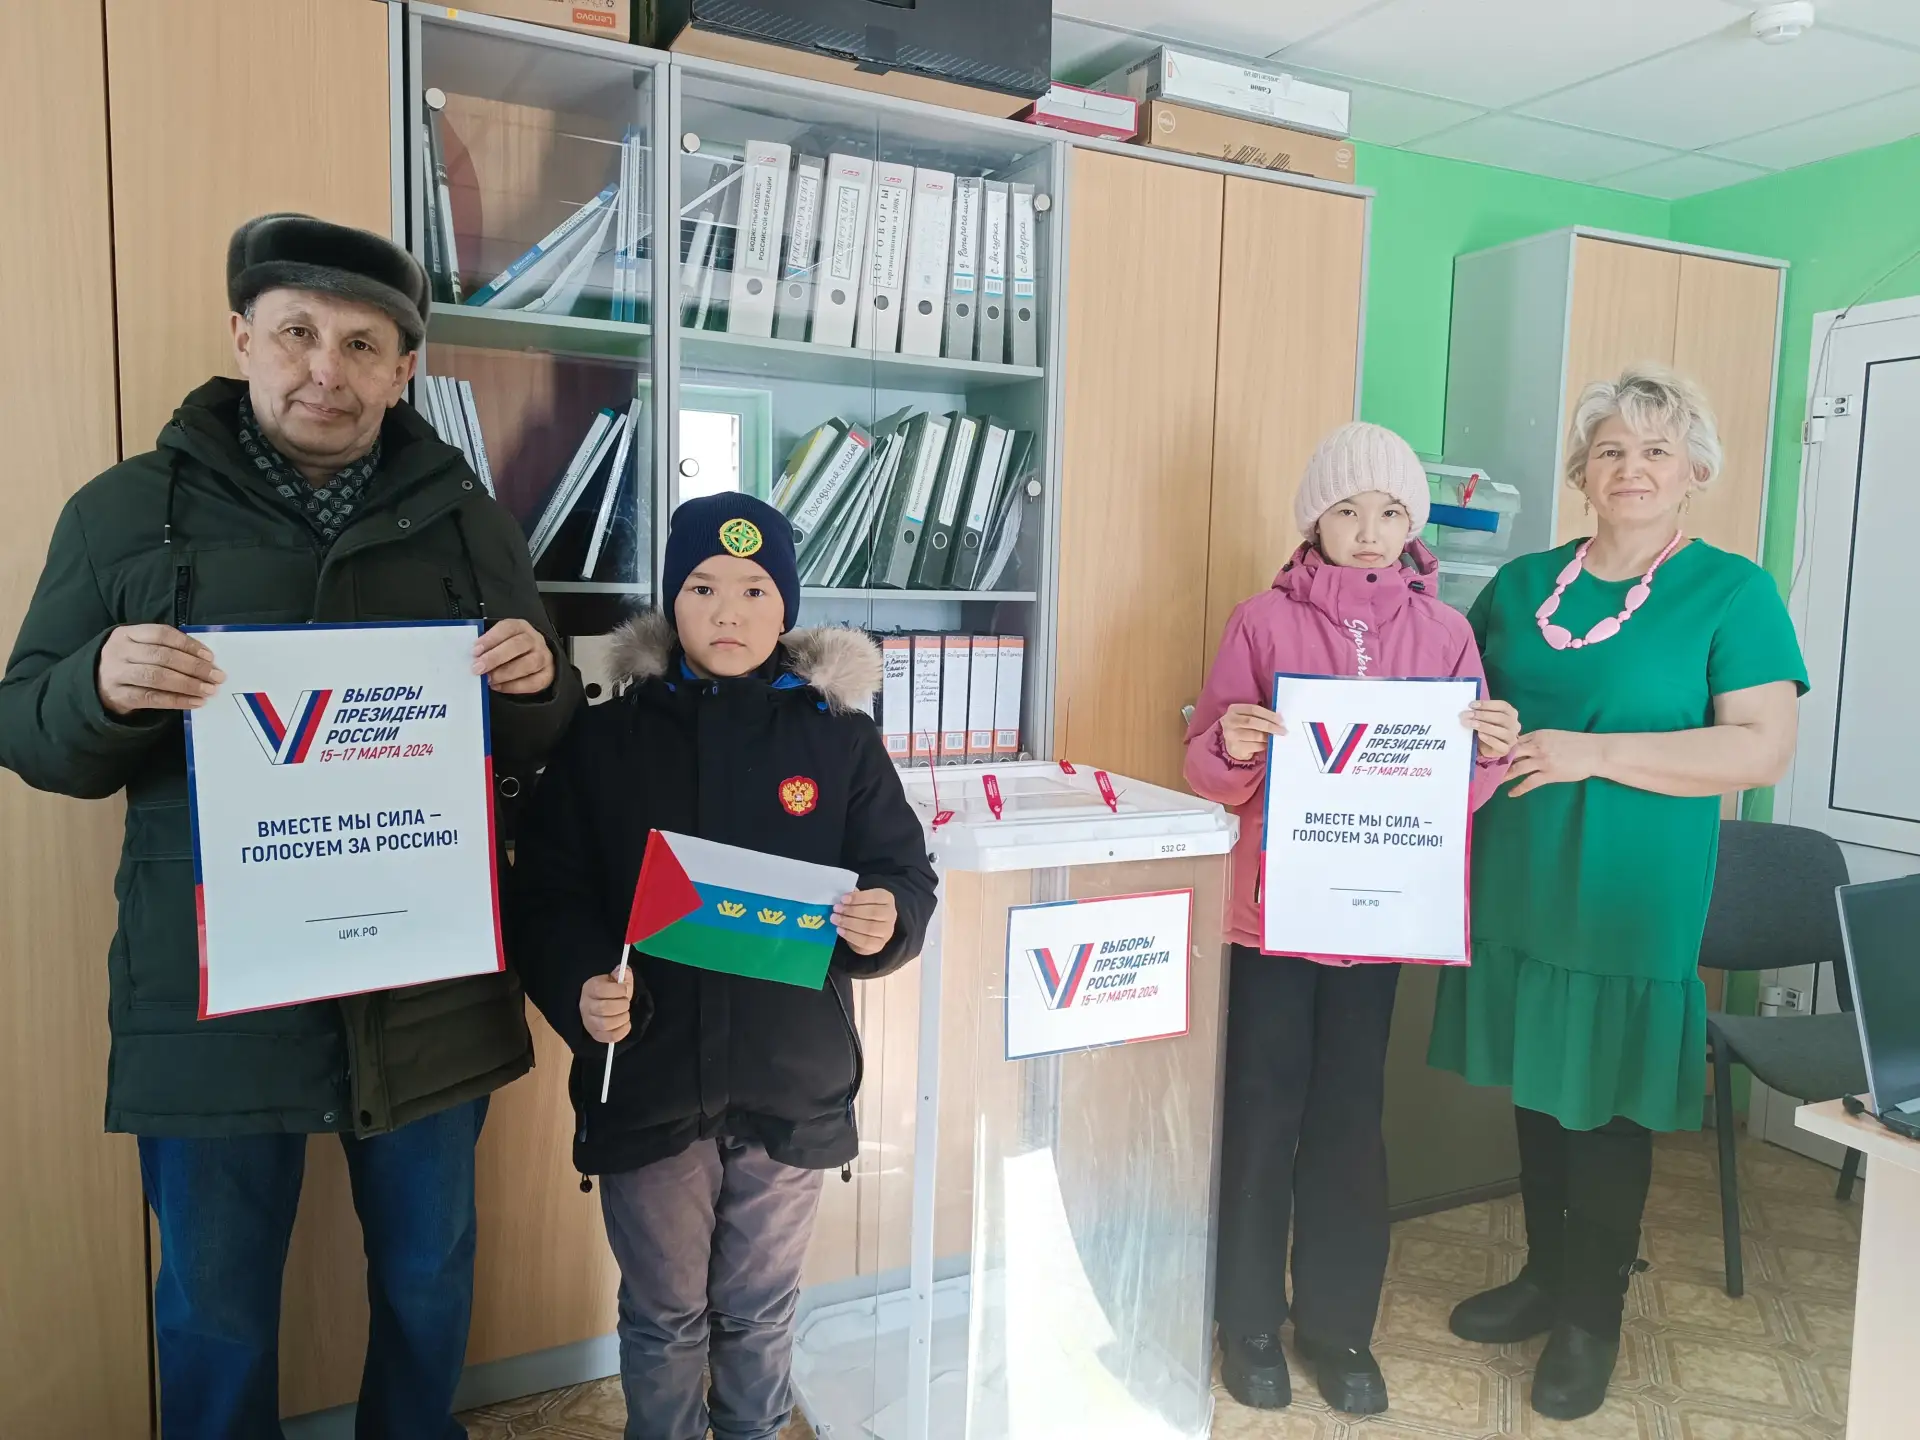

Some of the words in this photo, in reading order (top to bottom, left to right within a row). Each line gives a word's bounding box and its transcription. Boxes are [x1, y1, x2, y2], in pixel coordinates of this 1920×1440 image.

[576, 12, 612, 25] Lenovo
[1250, 84, 1272, 94] Canon
[753, 182, 762, 208] КОДЕКС
[762, 176, 772, 216] ФЕДЕРАЦИИ
[749, 209, 759, 252] БЮДЖЕТНЫЙ
[758, 217, 768, 260] РОССИЙСКОЙ
[341, 685, 424, 703] ВЫБОРЫ
[333, 704, 447, 724] ПРЕЗИДЕНТА
[325, 726, 400, 745] РОССИИ
[1373, 723, 1432, 736] ВЫБОРЫ
[356, 745, 401, 761] МАРТА
[402, 743, 434, 758] 2024
[1365, 738, 1447, 751] ПРЕЗИДЕНТА
[1357, 752, 1411, 764] РОССИИ
[1378, 766, 1409, 777] МАРТА
[1409, 767, 1433, 777] 2024
[257, 815, 333, 838] ВМЕСТЕ
[338, 813, 371, 831] МЫ
[376, 808, 425, 829] СИЛА
[1305, 812, 1355, 826] ВМЕСТЕ
[1358, 814, 1382, 827] МЫ
[1385, 815, 1420, 828] СИЛА
[241, 839, 343, 864] ГОЛОСУЕМ
[348, 836, 371, 854] ЗА
[376, 829, 459, 852] РОССИЮ!
[1292, 829, 1360, 844] ГОЛОСУЕМ
[1363, 832, 1379, 844] ЗА
[1383, 833, 1443, 847] РОССИЮ!
[1161, 844, 1174, 853] 532
[1352, 898, 1380, 907] ЦИК.РФ
[338, 925, 378, 940] ЦИК.РФ
[1100, 936, 1155, 954] ВЫБОРЫ
[1092, 951, 1170, 973] ПРЕЗИДЕНТА
[1086, 972, 1137, 990] РОССИИ
[1106, 988, 1137, 1003] МАРТА
[1137, 985, 1159, 998] 2024
